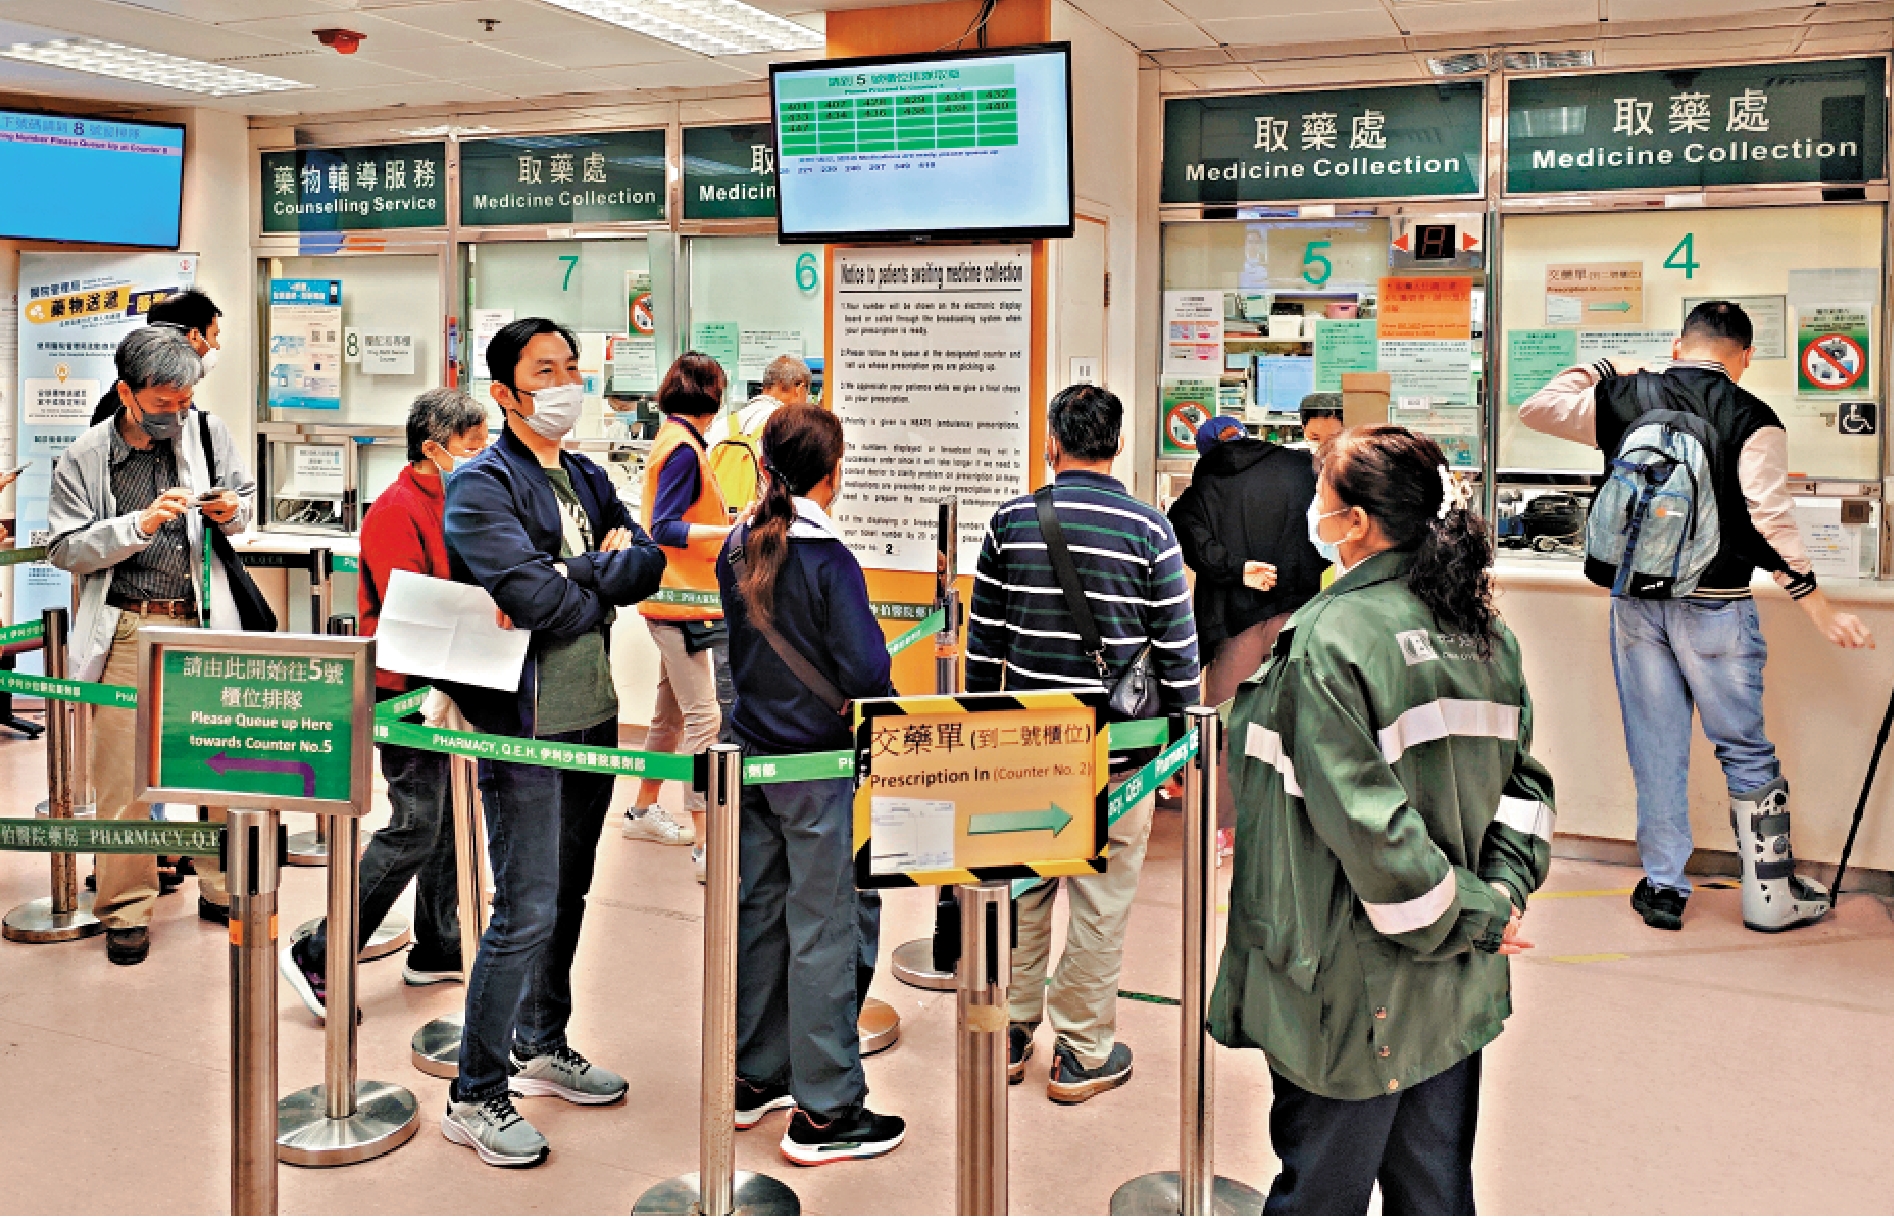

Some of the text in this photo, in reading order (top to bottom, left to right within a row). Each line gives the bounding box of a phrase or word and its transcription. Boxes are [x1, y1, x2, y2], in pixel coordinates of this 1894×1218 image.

[857, 74, 865, 86] 5
[1613, 88, 1770, 137] 取藥處
[74, 121, 84, 135] 8
[1254, 109, 1387, 153] 取藥處
[1532, 137, 1858, 170] Medicine Collection
[274, 159, 437, 196] 藥物輔導服務
[518, 151, 607, 185] 取藥處
[1186, 154, 1460, 182] Medicine Collection
[274, 195, 436, 215] Counselling Service
[473, 188, 656, 209] Medicine Collection
[1303, 241, 1332, 285] 5
[1662, 232, 1700, 279] 4
[558, 255, 579, 291] 7
[795, 252, 818, 291] 6
[50, 290, 119, 317] 藥物送遞
[346, 332, 359, 356] 8
[885, 544, 894, 554] 2
[183, 655, 344, 685] 請由此開始往5號
[220, 686, 303, 711] 櫃位排隊
[191, 711, 333, 732] Please Queue up Here
[189, 734, 242, 748] towards
[245, 737, 296, 751] Counter
[432, 733, 499, 756] PHARMACY,
[502, 744, 537, 760] Q.E.H.
[870, 722, 1091, 758] 交藥單 (到二號櫃位)
[870, 769, 970, 789] Prescription
[974, 766, 990, 781] In
[993, 765, 1049, 781] (Counter
[1053, 763, 1075, 775] No.
